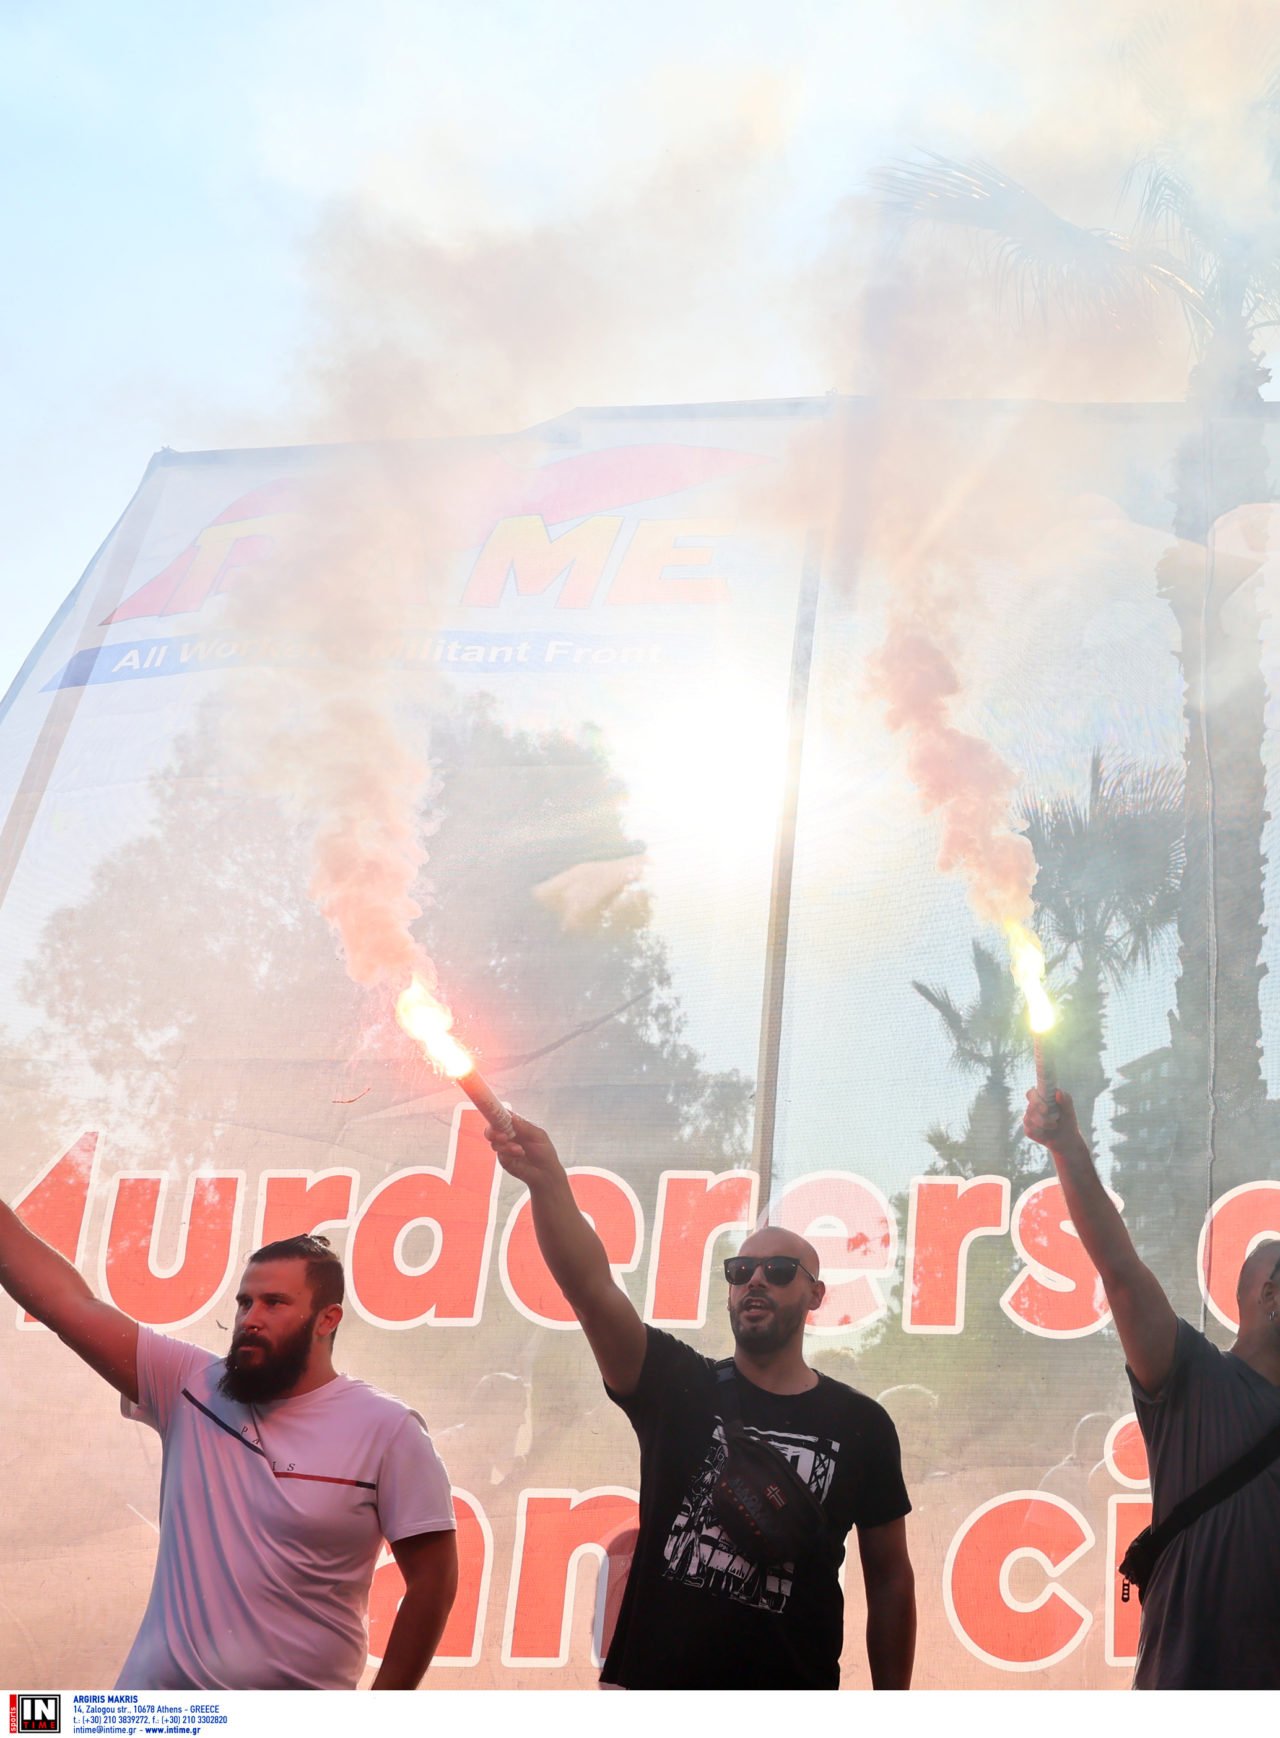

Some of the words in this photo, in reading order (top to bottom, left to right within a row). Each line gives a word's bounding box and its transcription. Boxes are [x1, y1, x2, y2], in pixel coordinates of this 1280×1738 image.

[159, 512, 737, 618] PME
[112, 643, 169, 673] All
[179, 639, 338, 665] Worker
[544, 639, 666, 665] Front
